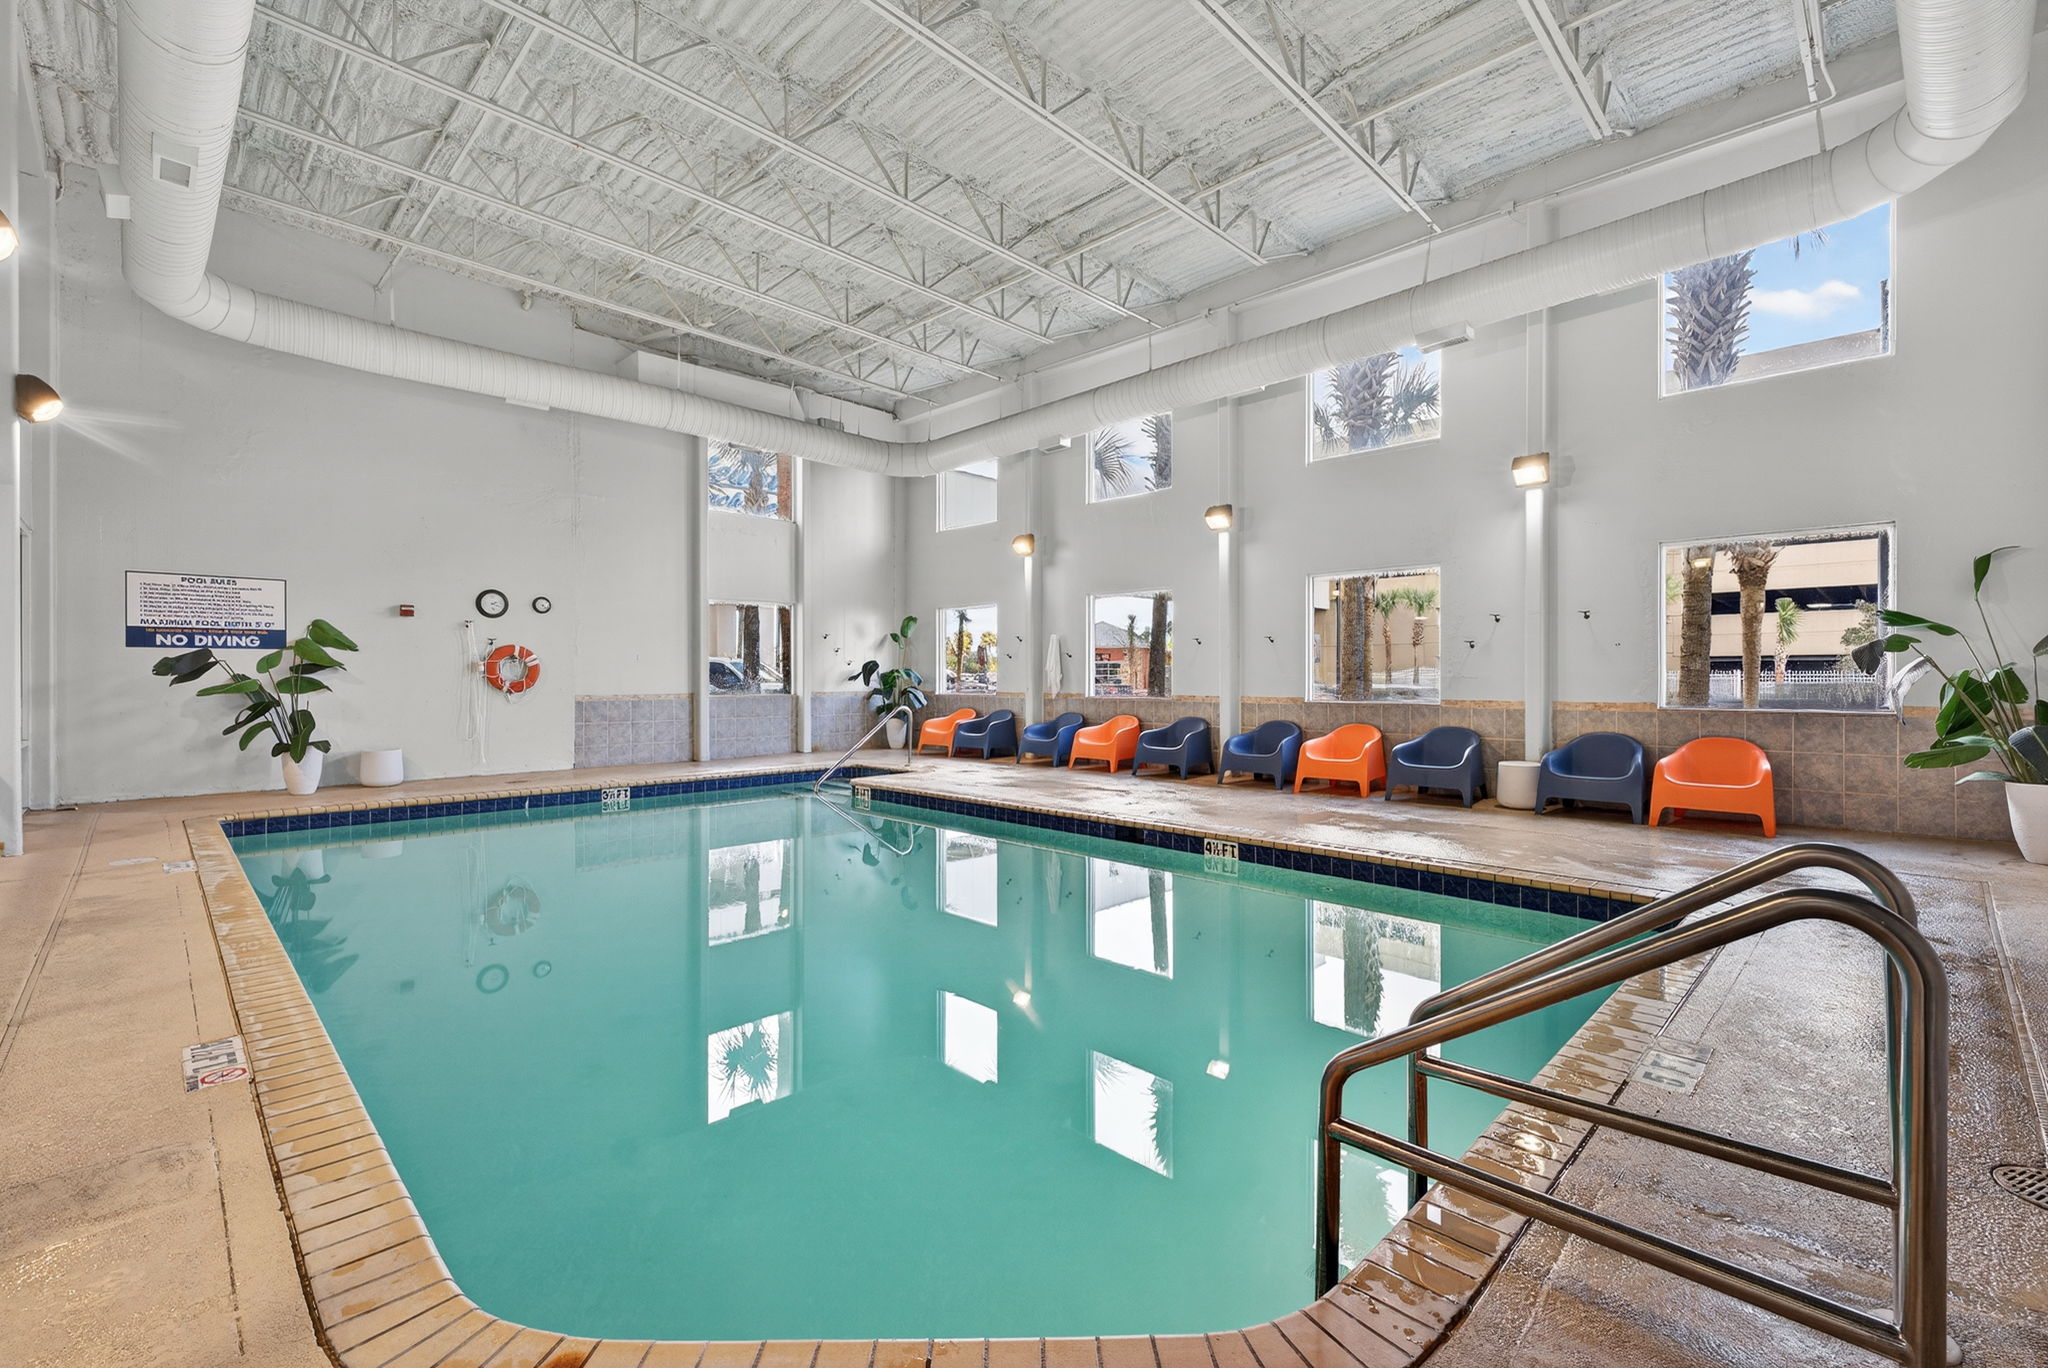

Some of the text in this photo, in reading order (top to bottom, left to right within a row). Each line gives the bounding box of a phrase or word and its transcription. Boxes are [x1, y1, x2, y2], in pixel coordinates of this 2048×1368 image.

[180, 576, 238, 586] POOL RULES
[140, 618, 193, 627] MAXIMUM
[155, 633, 261, 647] NO DIVING
